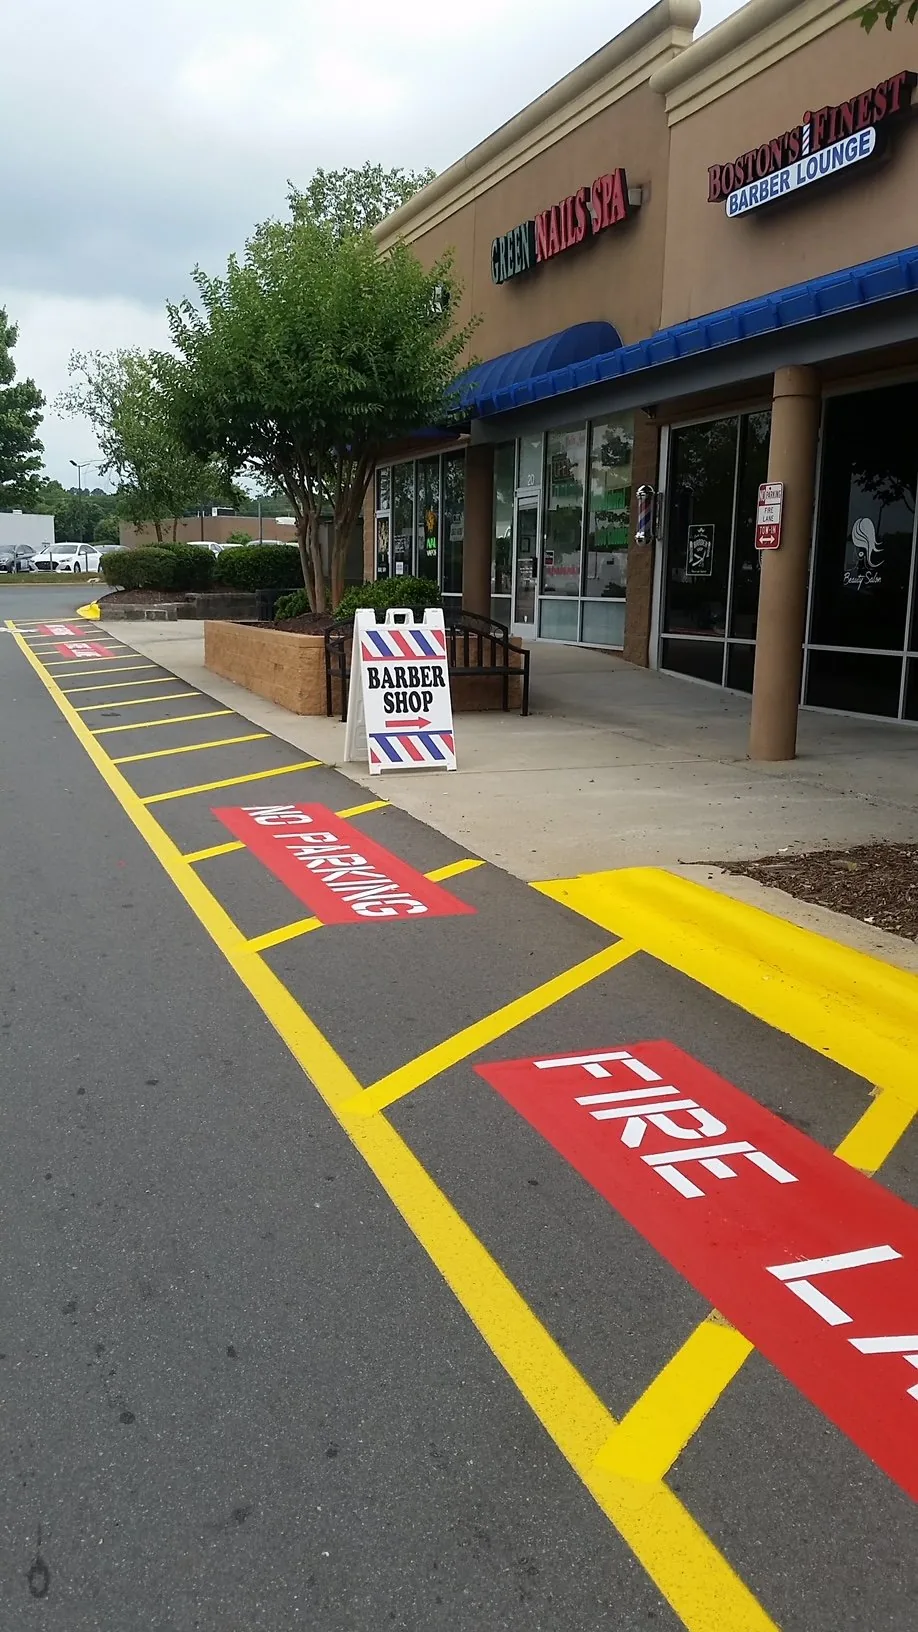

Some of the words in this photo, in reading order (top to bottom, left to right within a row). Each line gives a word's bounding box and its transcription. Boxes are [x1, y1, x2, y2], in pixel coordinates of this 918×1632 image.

[708, 124, 801, 203] BOSTON'S
[811, 71, 907, 151] FINEST
[729, 168, 791, 215] BARBER
[796, 129, 871, 186] LOUNGE
[490, 221, 534, 284] GREEN
[535, 187, 587, 263] NAILS
[591, 168, 627, 235] SPA
[527, 474, 535, 486] 20
[762, 515, 774, 523] LANE
[843, 572, 865, 591] Beauty
[864, 571, 882, 585] Salon
[367, 665, 446, 690] BARBER
[383, 690, 434, 714] SHOP
[241, 804, 314, 826] NO
[273, 831, 429, 917] PARKING
[533, 1050, 800, 1199] FIRE
